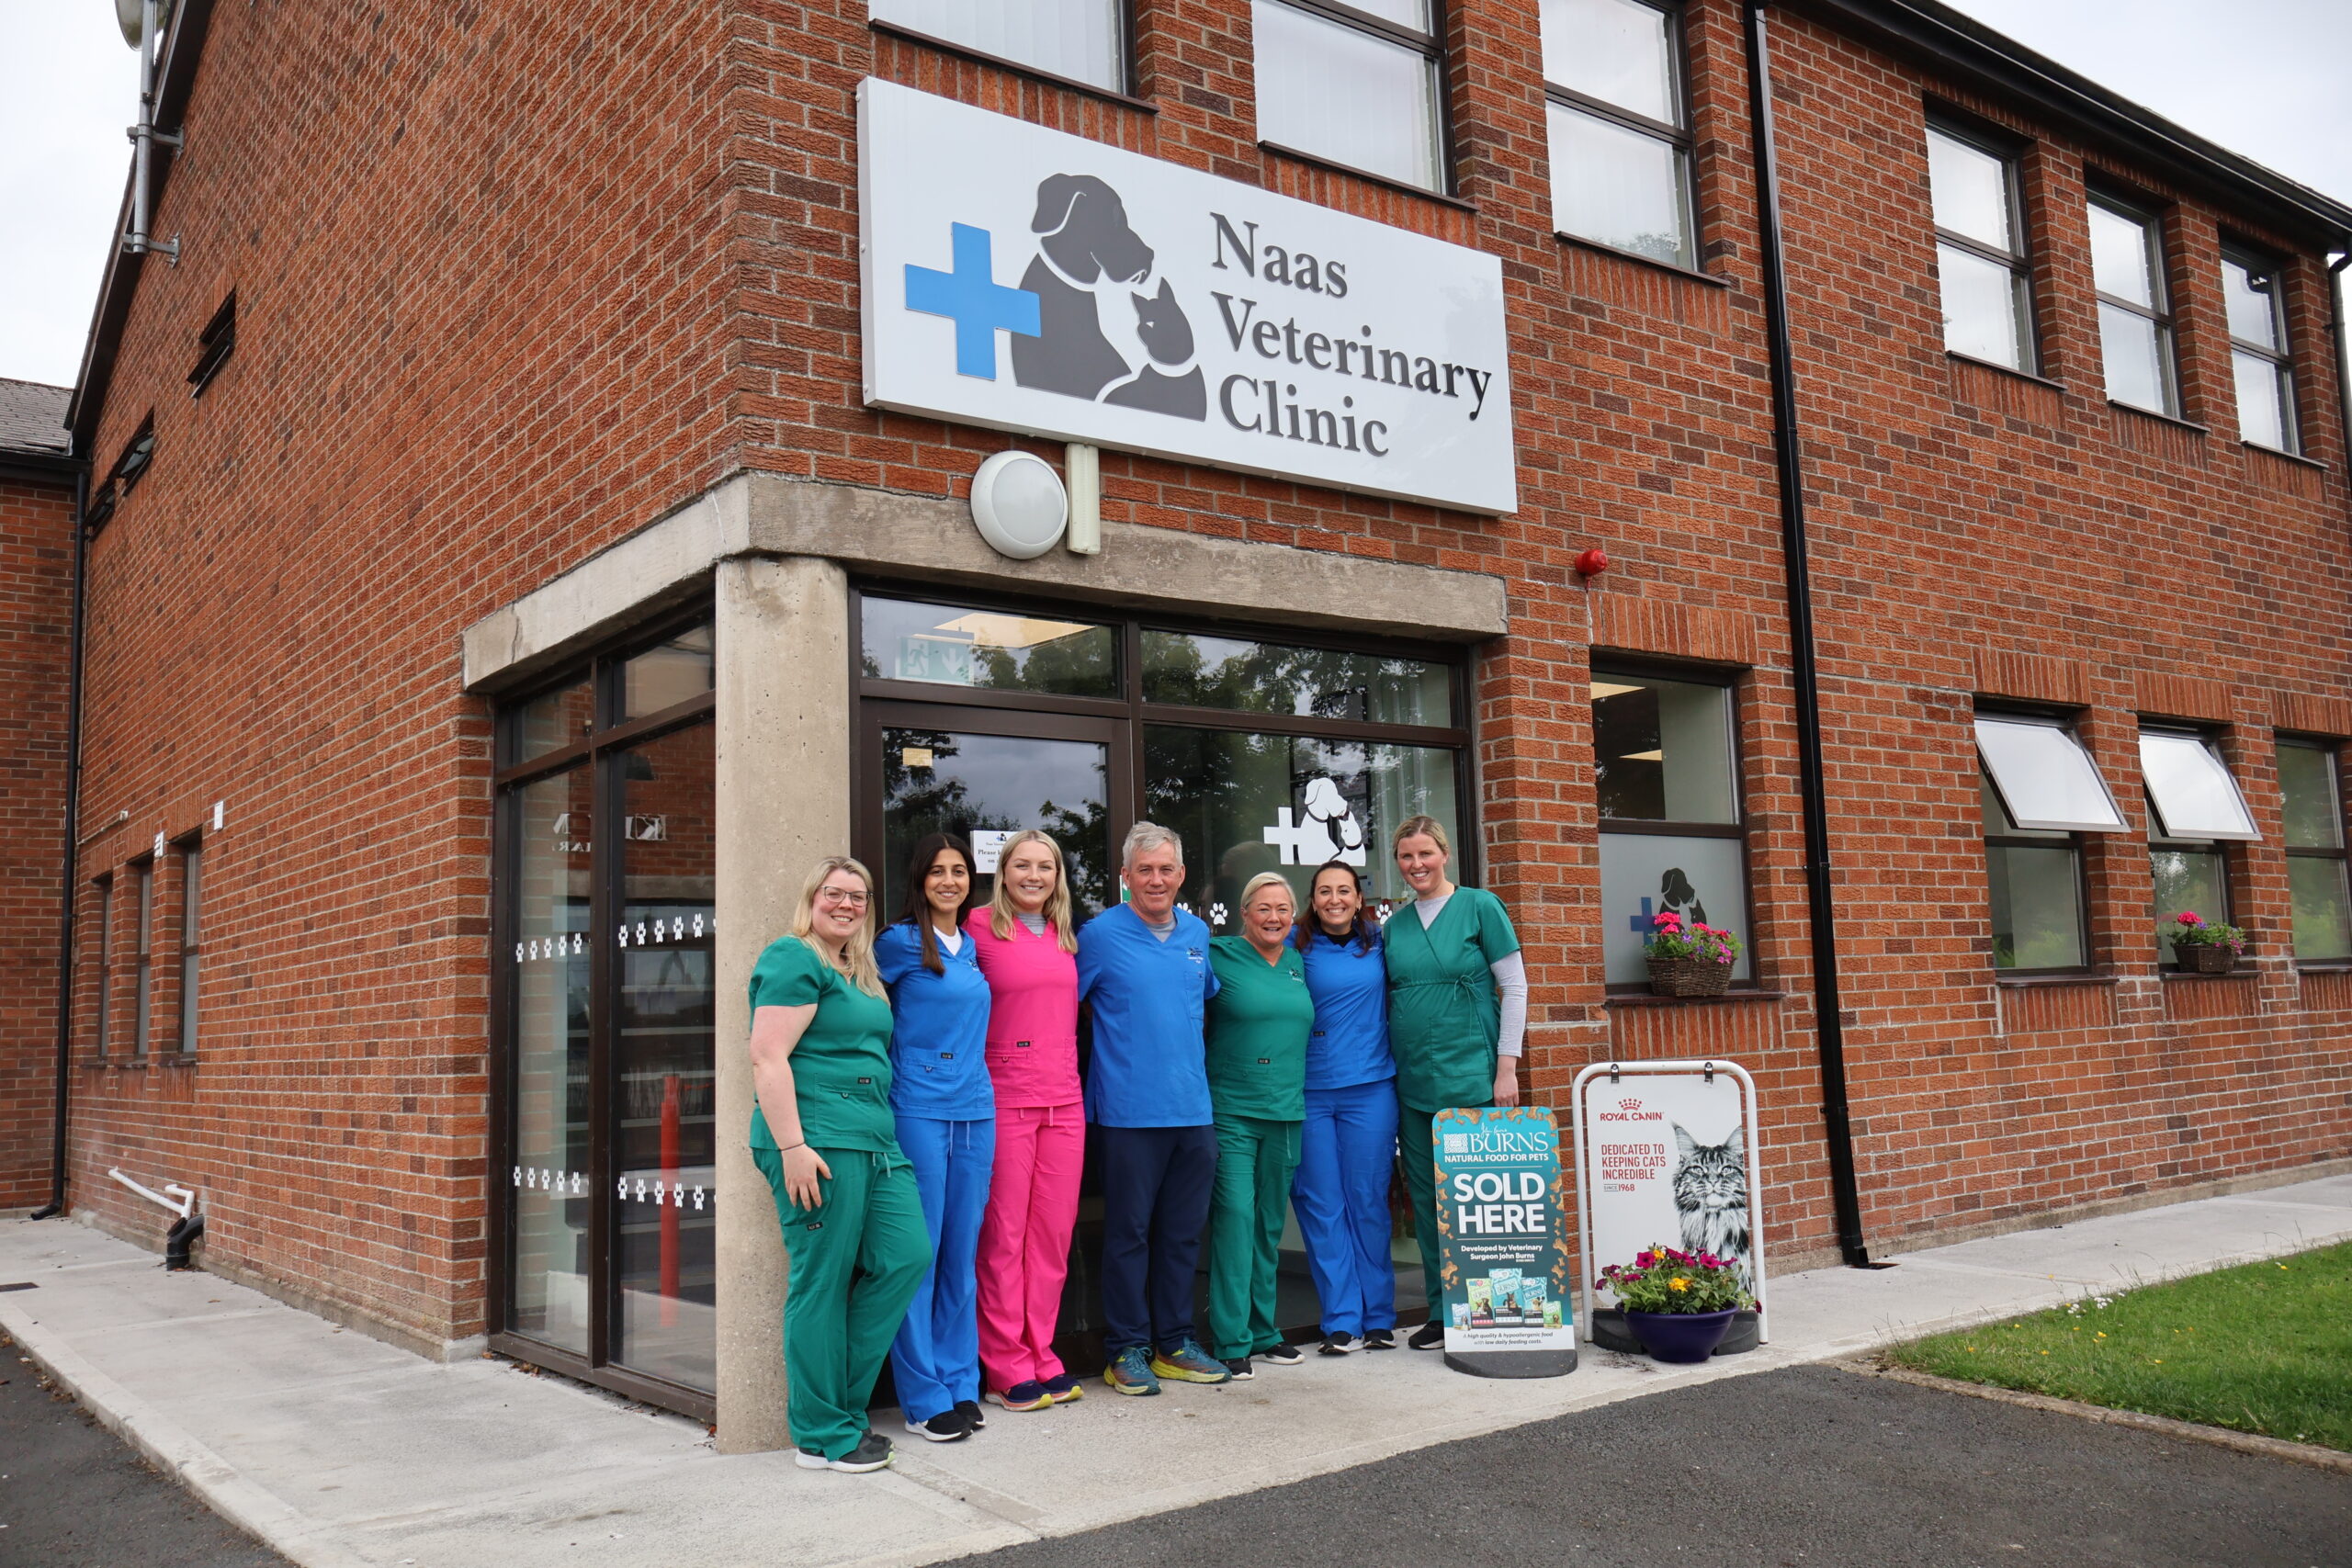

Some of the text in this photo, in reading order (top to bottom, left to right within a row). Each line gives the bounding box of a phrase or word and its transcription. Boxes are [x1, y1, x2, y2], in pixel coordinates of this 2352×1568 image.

[1209, 210, 1349, 299] Naas
[1210, 290, 1492, 421] Veterinary
[1219, 373, 1389, 457] Clinic
[1600, 1111, 1662, 1122] ROYAL CANIN
[1470, 1131, 1549, 1153] BURNS
[1601, 1144, 1665, 1155] DEDICATED TO
[1444, 1153, 1549, 1163] NATURAL FOOD FOR PETS
[1601, 1156, 1666, 1168] KEEPING CATS
[1602, 1168, 1656, 1180] INCREDIBLE
[1453, 1172, 1545, 1202] SOLD
[1618, 1183, 1635, 1191] 1968
[1457, 1203, 1546, 1234] HERE
[1461, 1245, 1498, 1253] Developed
[1470, 1253, 1498, 1261] Surgeon
